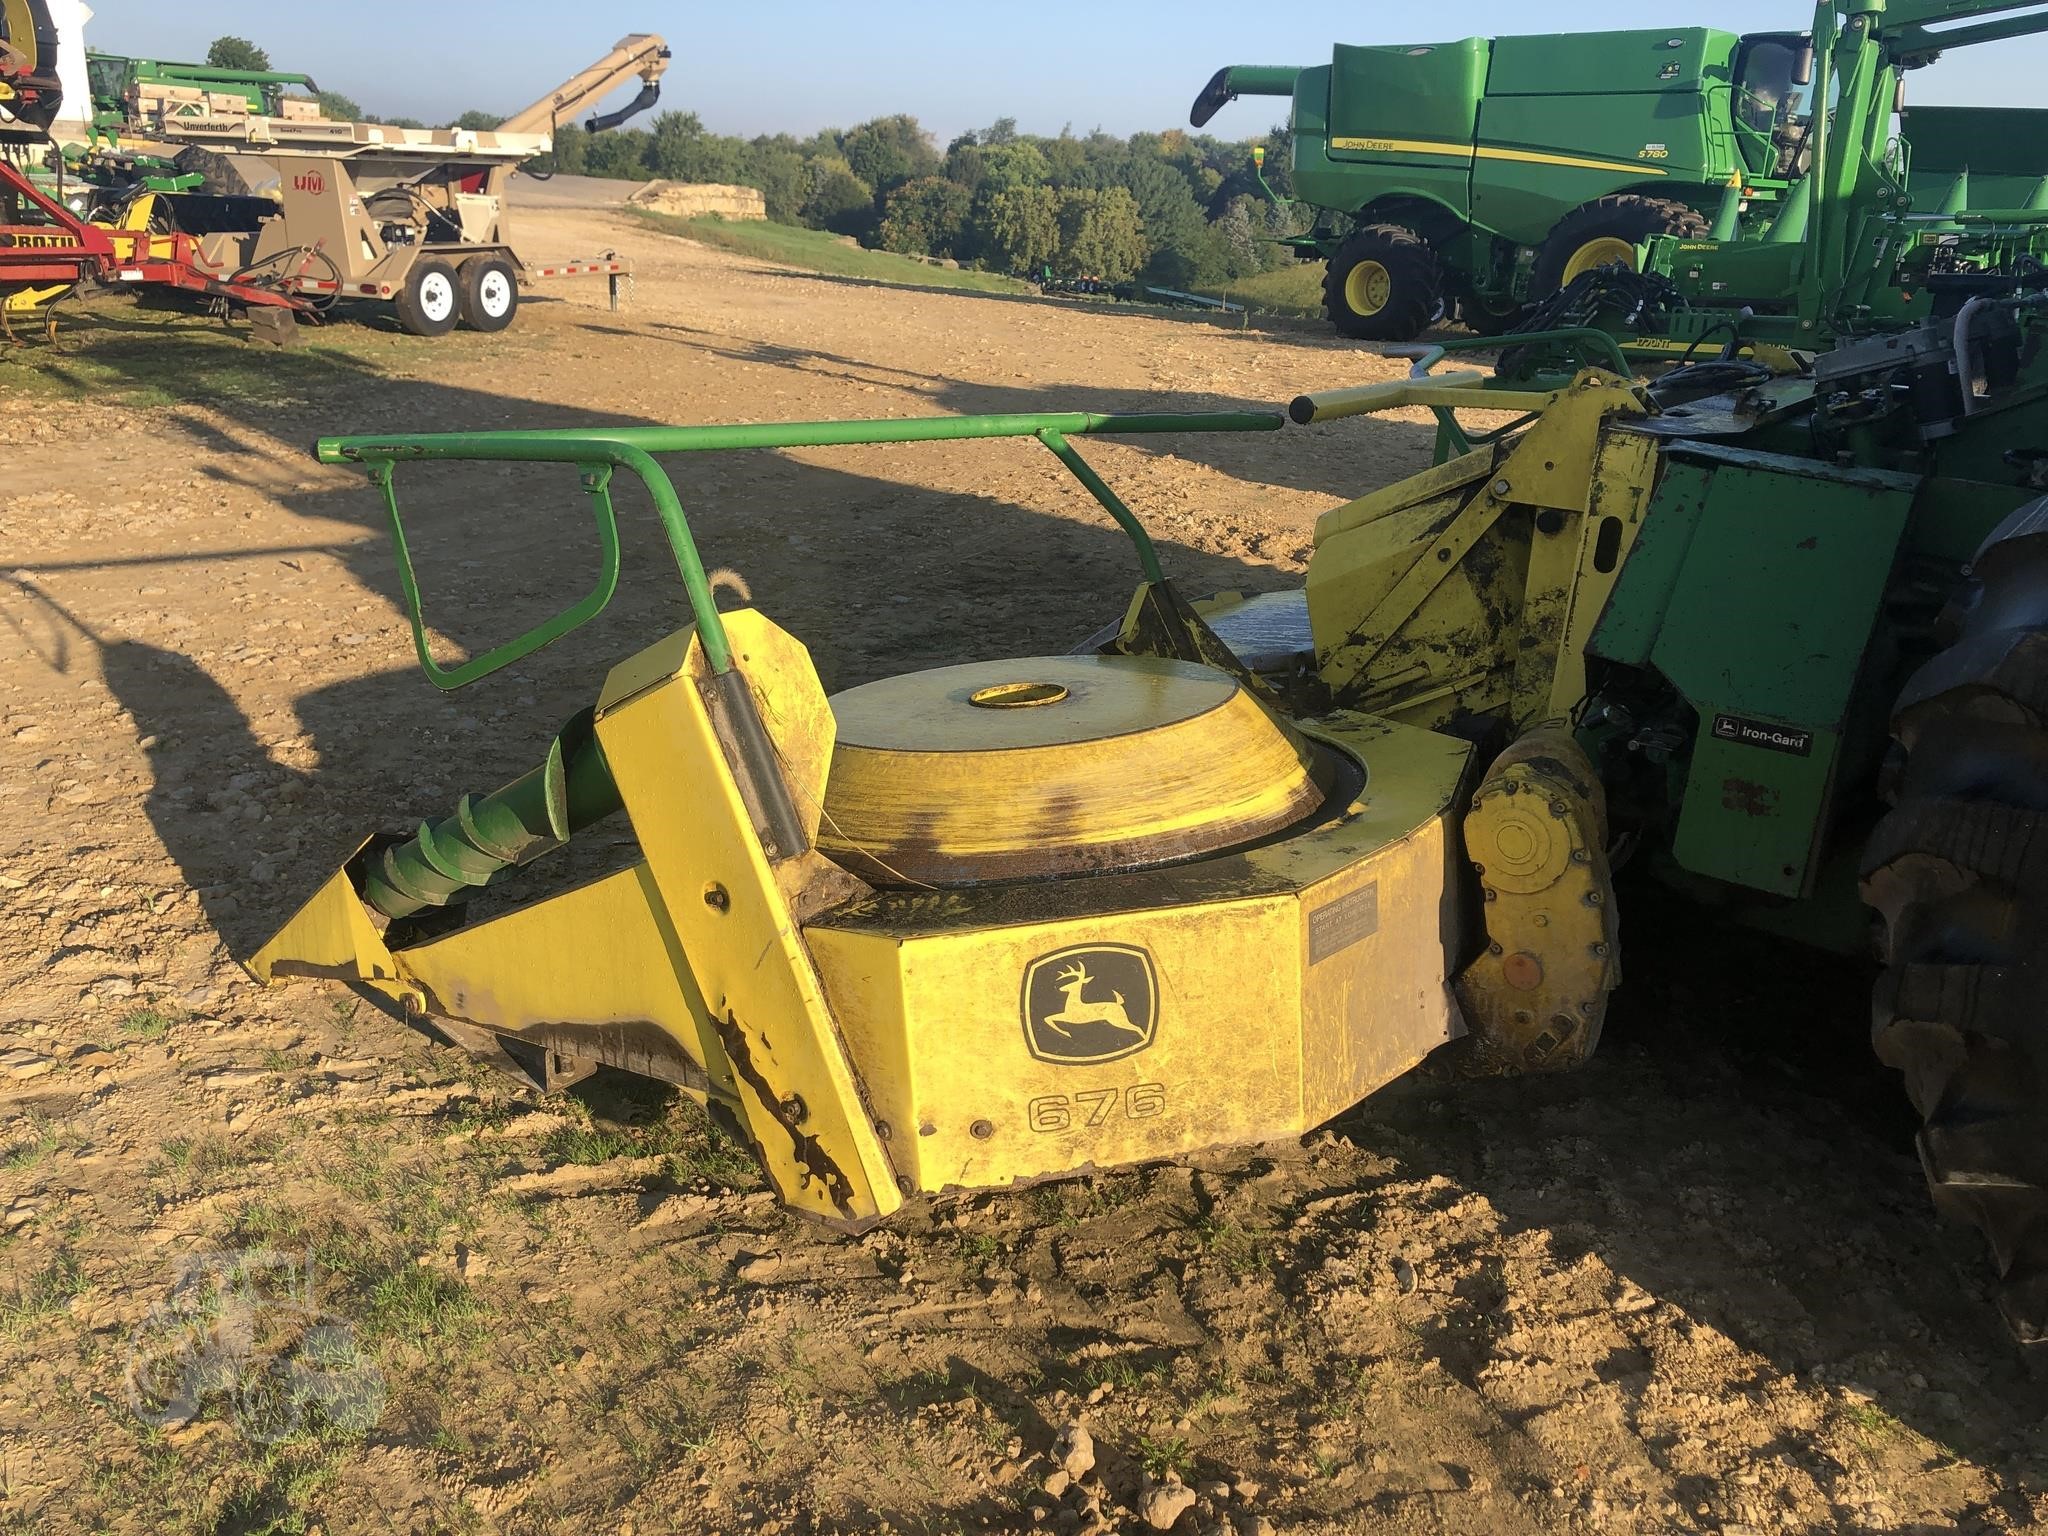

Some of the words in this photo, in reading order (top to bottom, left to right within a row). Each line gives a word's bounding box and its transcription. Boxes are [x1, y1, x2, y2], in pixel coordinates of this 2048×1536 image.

[183, 121, 228, 132] Unverferth
[1344, 140, 1365, 149] JOHN
[1366, 140, 1394, 150] DEERE
[1697, 243, 1719, 251] DEERE
[1636, 337, 1671, 348] 1770NT
[1028, 1082, 1166, 1133] 676
